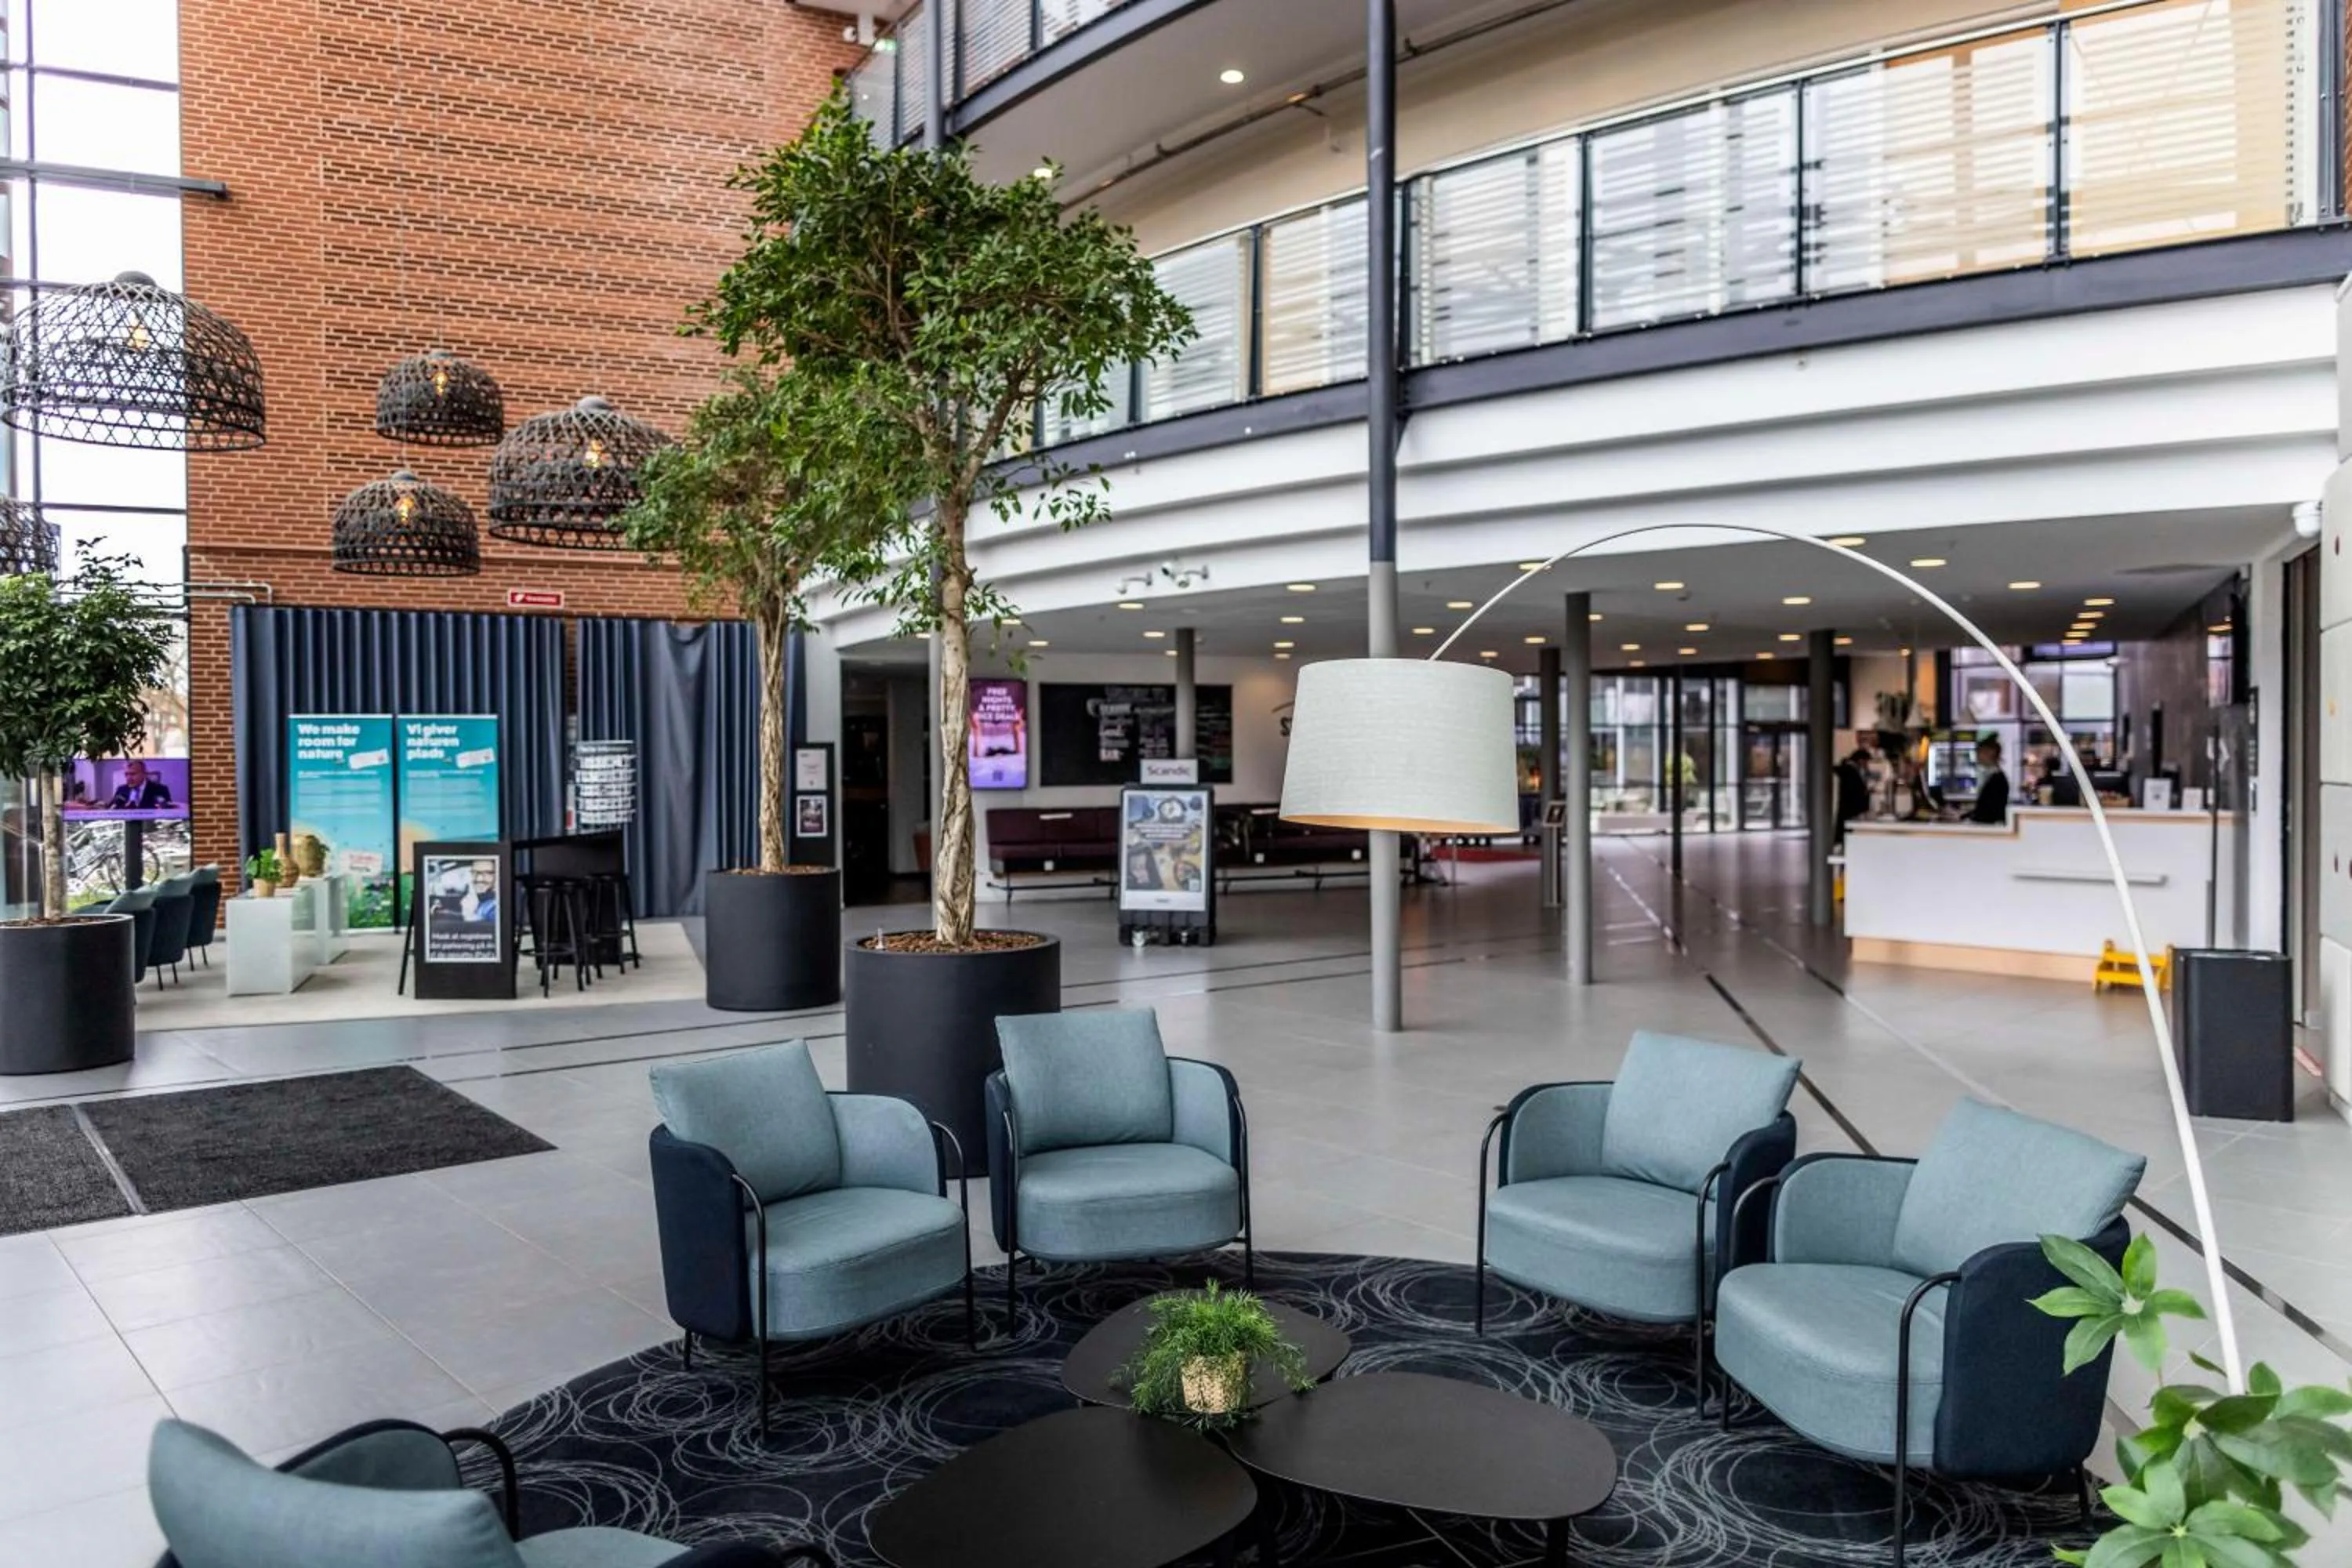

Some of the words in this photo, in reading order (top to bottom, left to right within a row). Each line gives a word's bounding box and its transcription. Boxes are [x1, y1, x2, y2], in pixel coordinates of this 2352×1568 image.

[297, 724, 320, 735] We
[321, 724, 361, 735] make
[406, 724, 421, 735] Vi
[423, 724, 458, 738] giver
[297, 738, 336, 747] room
[336, 736, 358, 747] for
[406, 736, 460, 747] naturen
[297, 749, 343, 760] nature
[1147, 764, 1191, 776] Scandic
